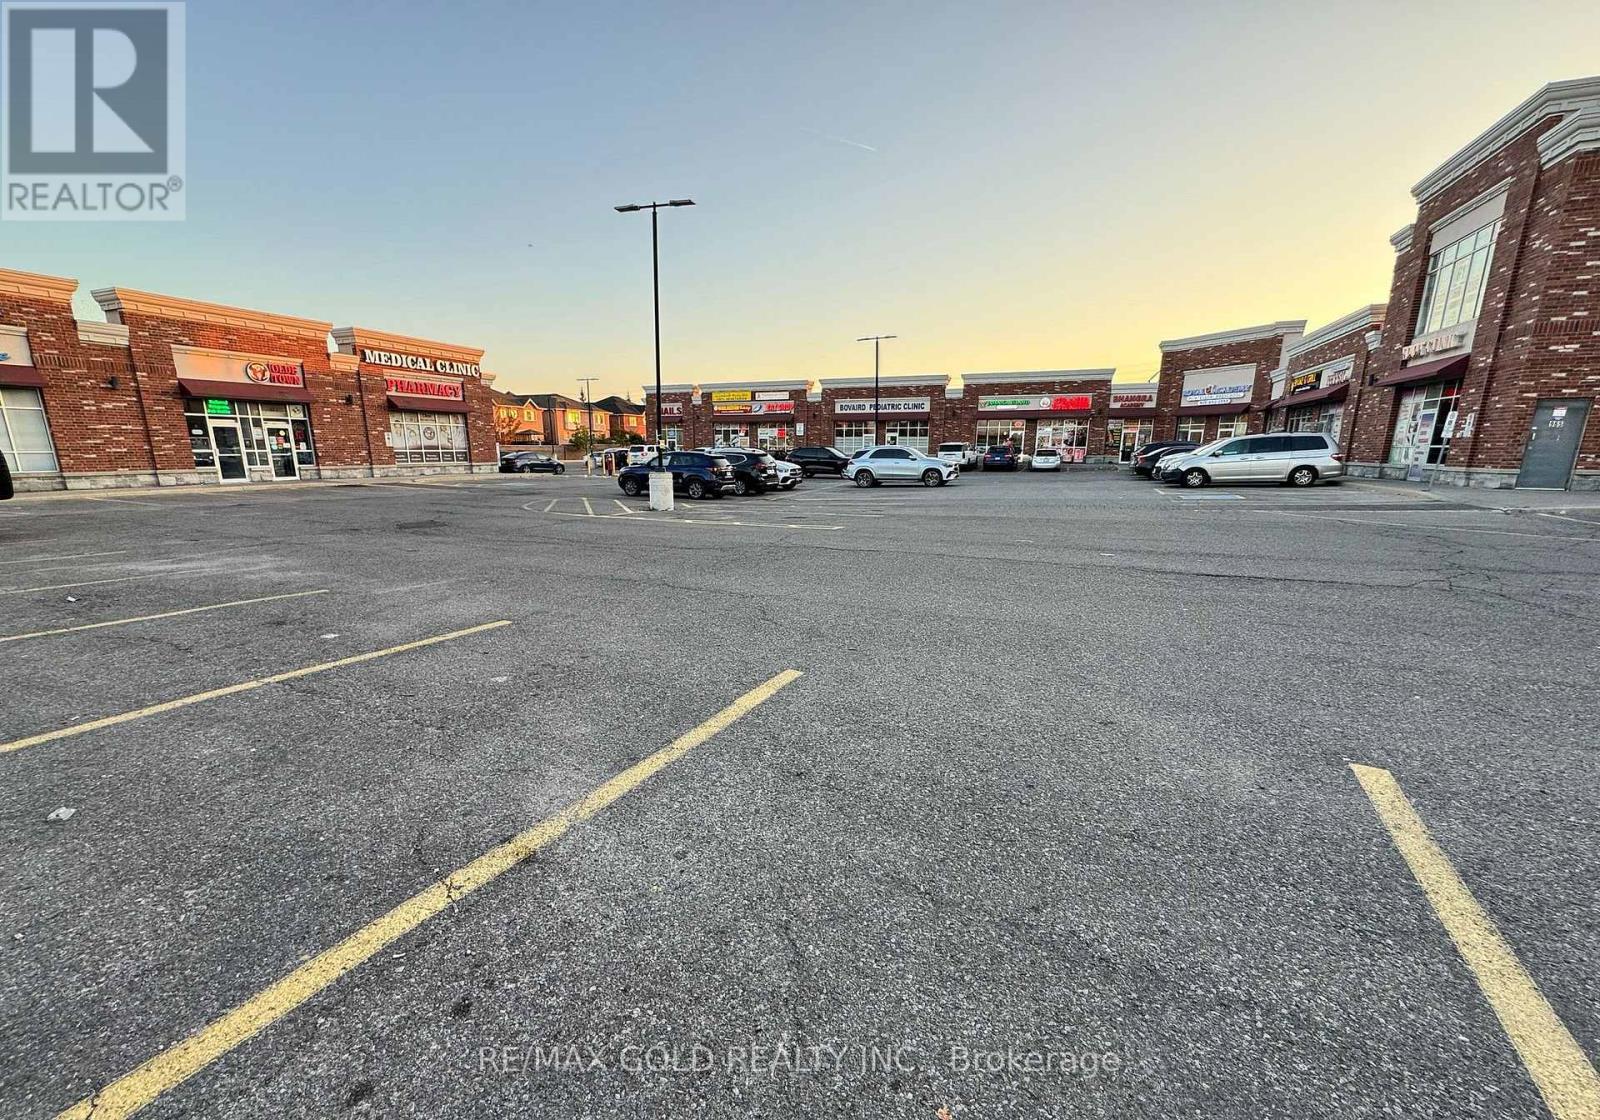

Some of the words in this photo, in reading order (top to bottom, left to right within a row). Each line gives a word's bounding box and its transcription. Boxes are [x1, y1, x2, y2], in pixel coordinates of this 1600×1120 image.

[364, 350, 435, 371] MEDICAL
[436, 360, 481, 377] CLINIC
[271, 374, 302, 385] TOWN
[387, 379, 461, 398] PHARMACY
[840, 403, 866, 411] BOVAIRD
[903, 402, 925, 410] CLINIC
